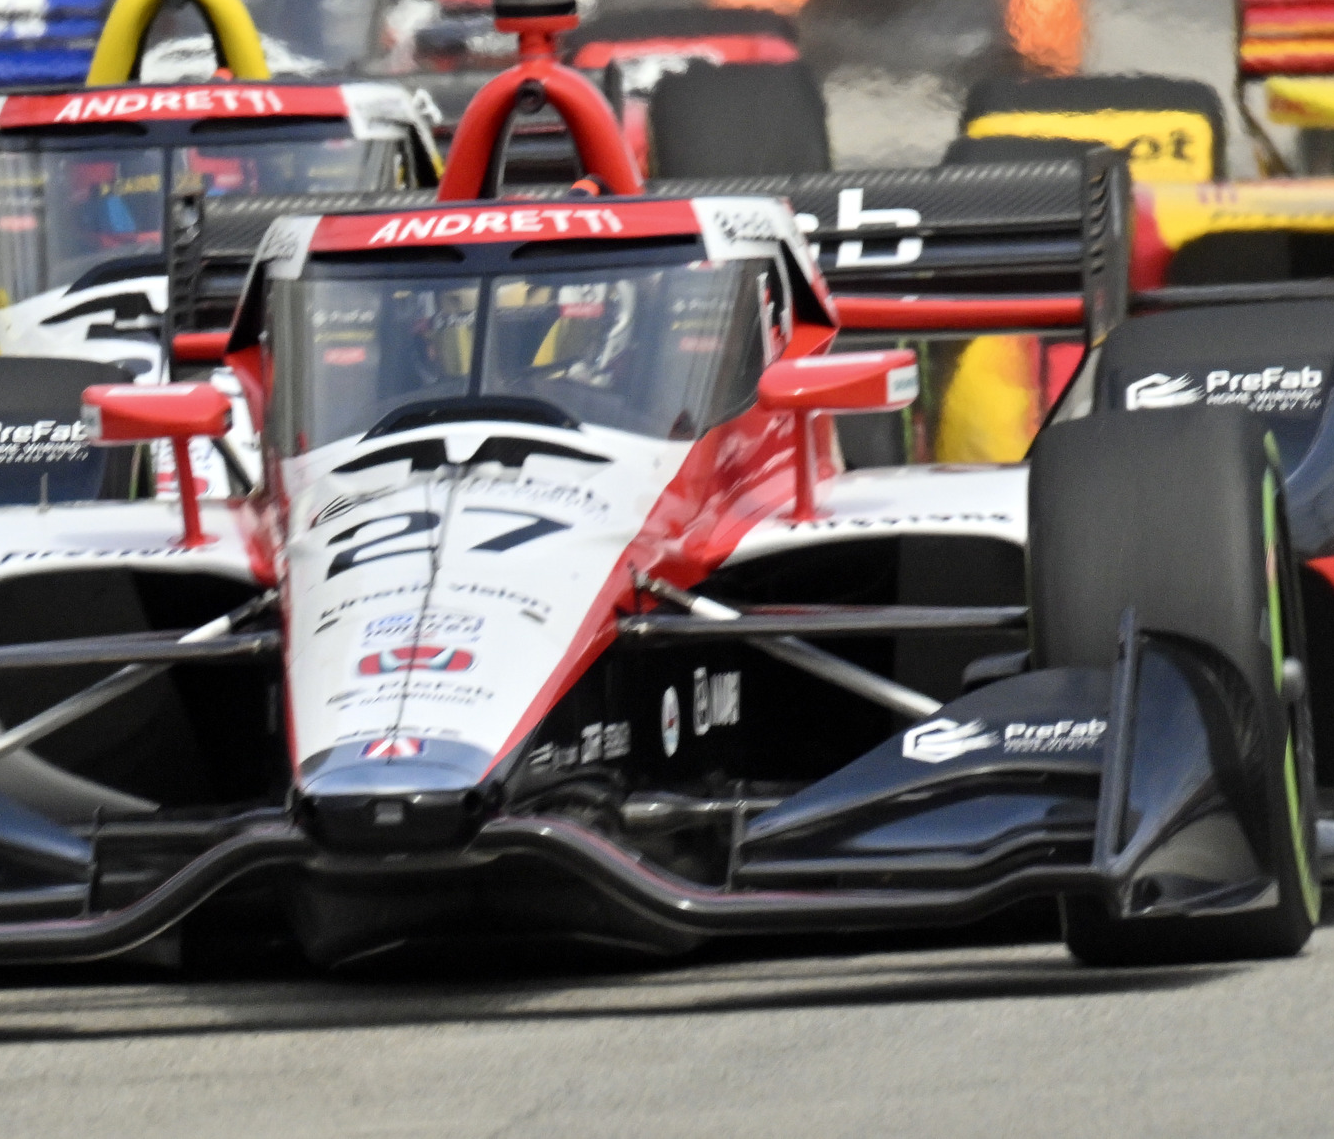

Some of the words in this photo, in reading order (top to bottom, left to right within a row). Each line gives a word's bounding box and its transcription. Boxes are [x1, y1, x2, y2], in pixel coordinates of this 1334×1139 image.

[54, 87, 283, 123] ANDRETTI
[367, 208, 624, 245] ANDRETTI
[1207, 366, 1322, 392] PreFab
[325, 508, 573, 581] 27
[1005, 718, 1107, 738] PreFab
